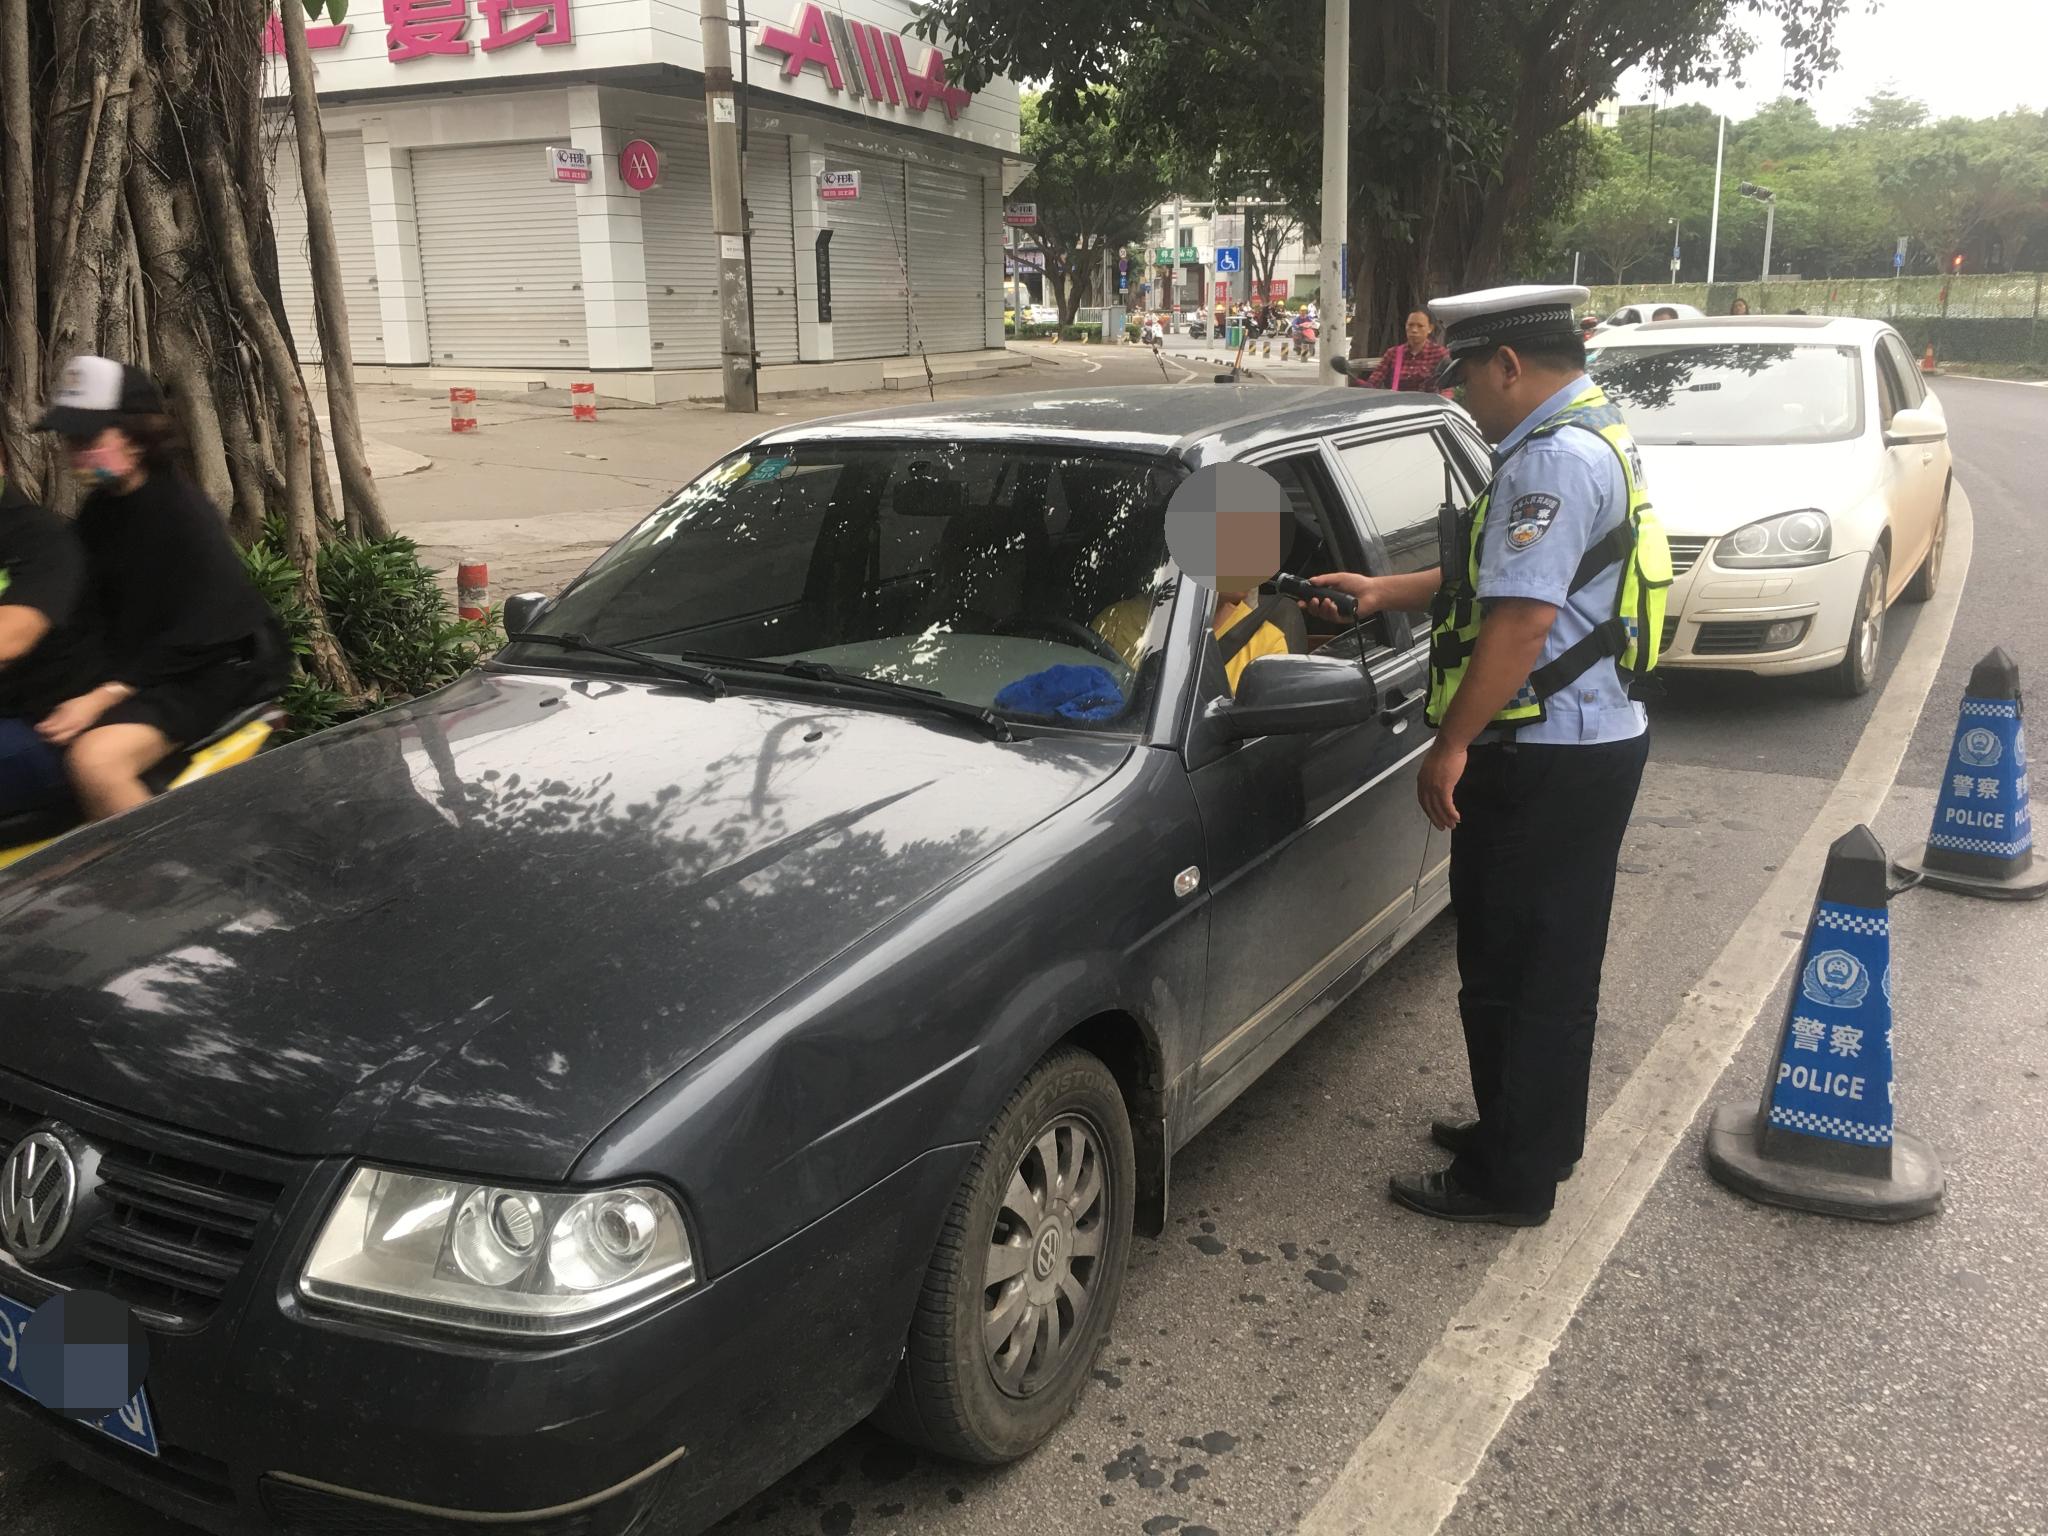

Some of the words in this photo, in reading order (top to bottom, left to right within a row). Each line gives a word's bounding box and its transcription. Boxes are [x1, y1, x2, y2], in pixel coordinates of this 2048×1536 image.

[1952, 774, 1999, 799] 警察
[1945, 807, 2005, 829] POLICE
[1792, 1016, 1864, 1058] 警察
[1776, 1062, 1865, 1100] POLICE
